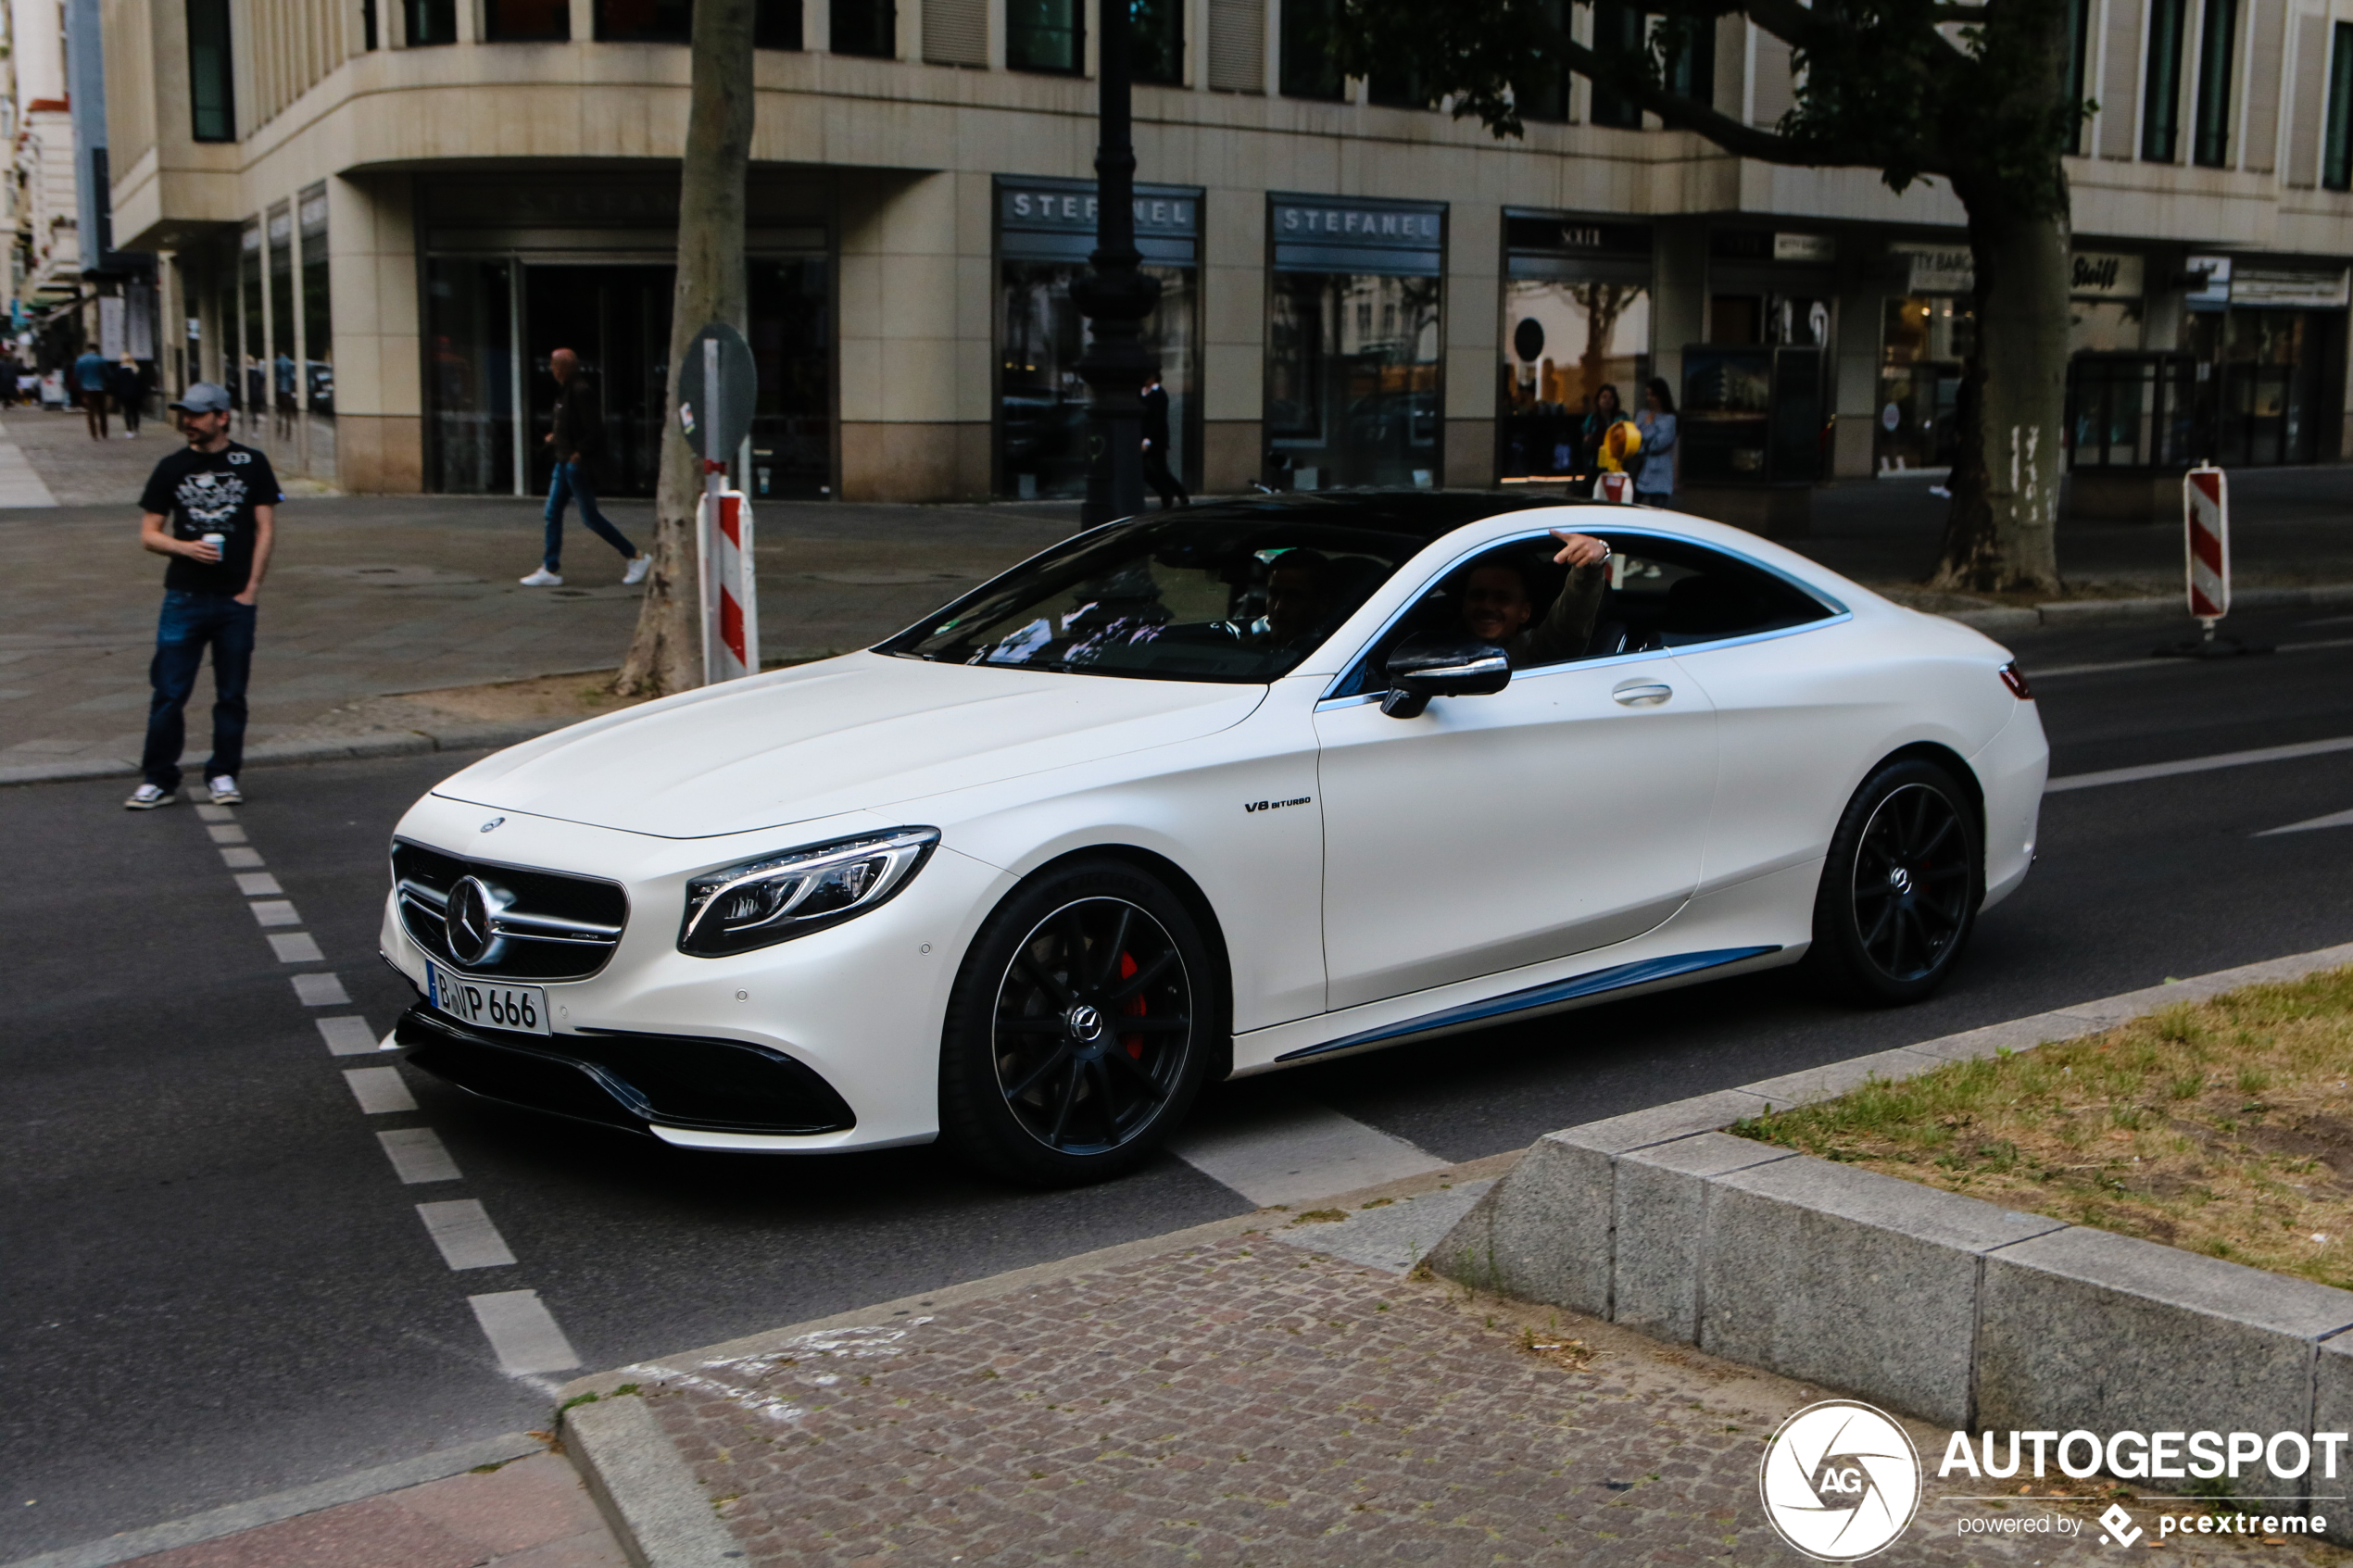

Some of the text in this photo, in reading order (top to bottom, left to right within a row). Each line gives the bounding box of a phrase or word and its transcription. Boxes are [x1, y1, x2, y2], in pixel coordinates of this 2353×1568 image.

[1013, 193, 1185, 223] STEFNEL
[1284, 208, 1432, 237] STEFANEL
[1244, 797, 1311, 813] V8 BITURBO
[437, 972, 536, 1028] B VP 666
